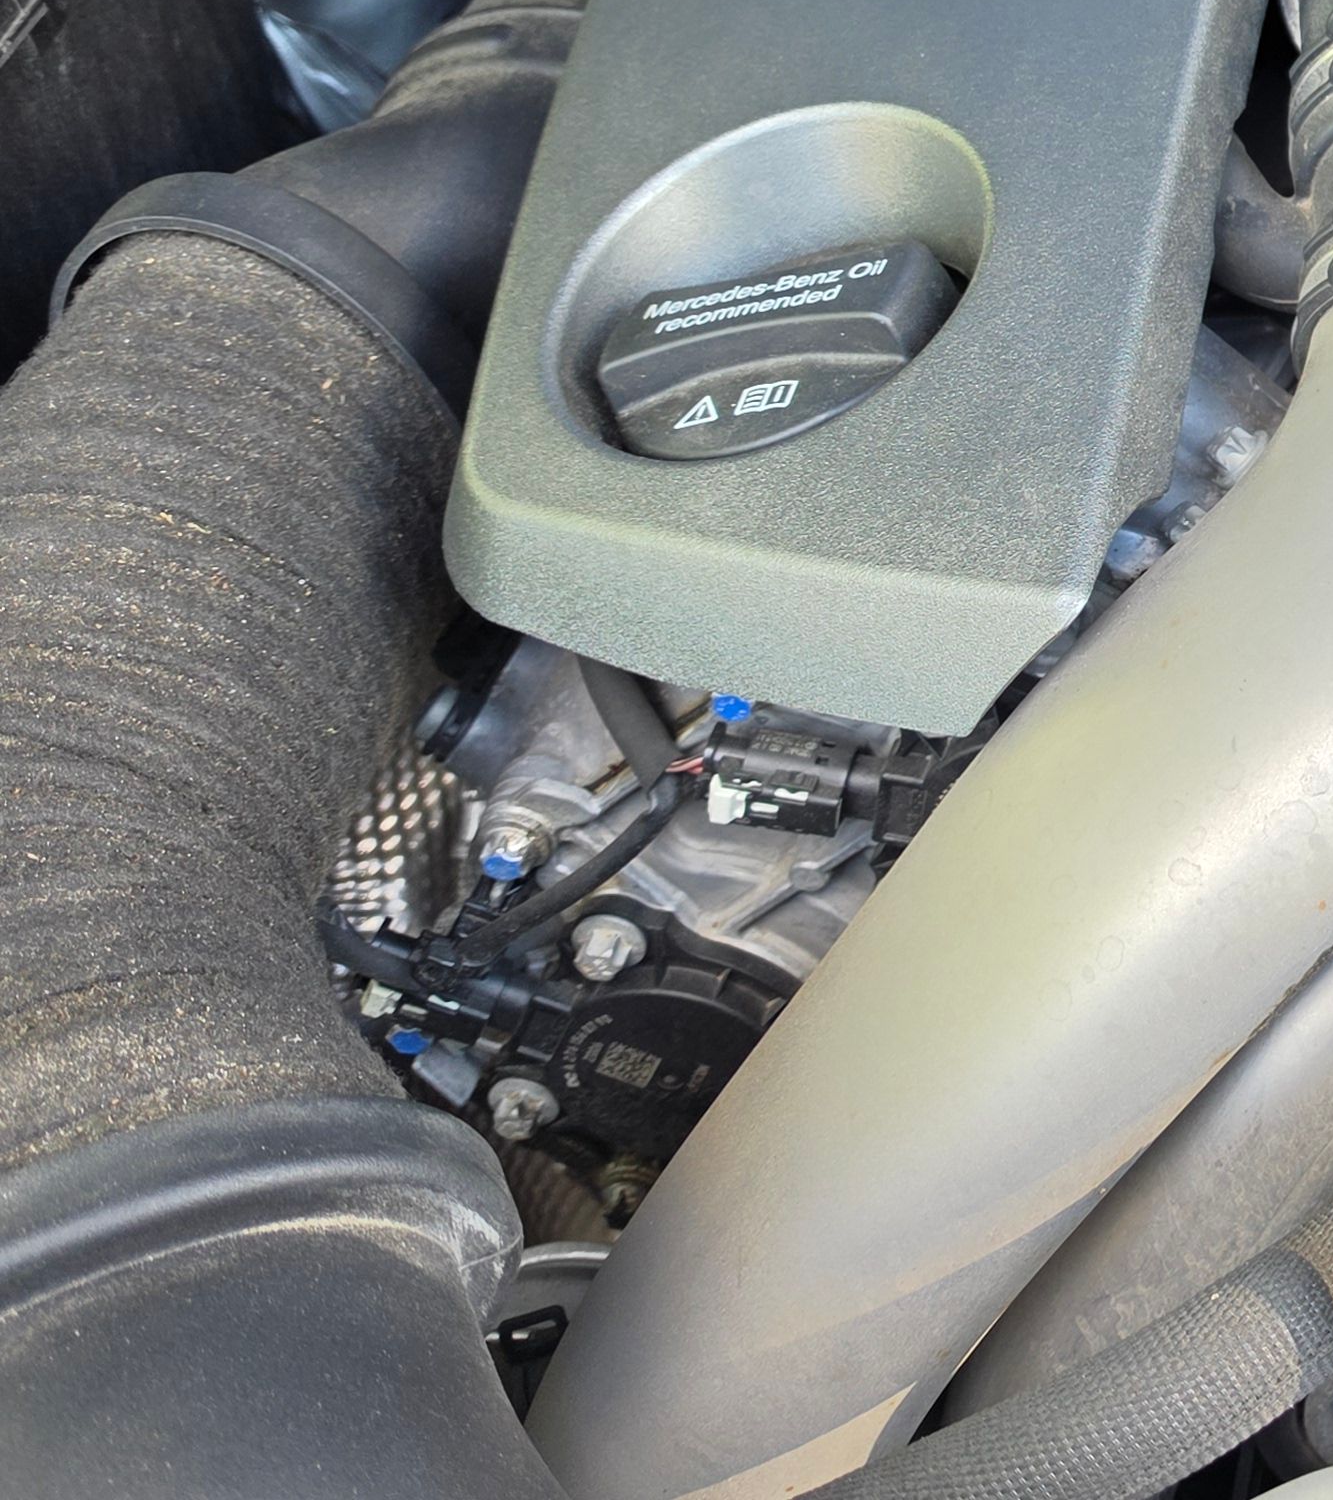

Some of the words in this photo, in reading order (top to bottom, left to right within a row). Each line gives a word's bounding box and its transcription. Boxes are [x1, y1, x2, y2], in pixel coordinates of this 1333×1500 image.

[643, 268, 844, 321] Mercedes-Benz
[847, 259, 889, 280] Oil
[654, 284, 844, 335] recommended
